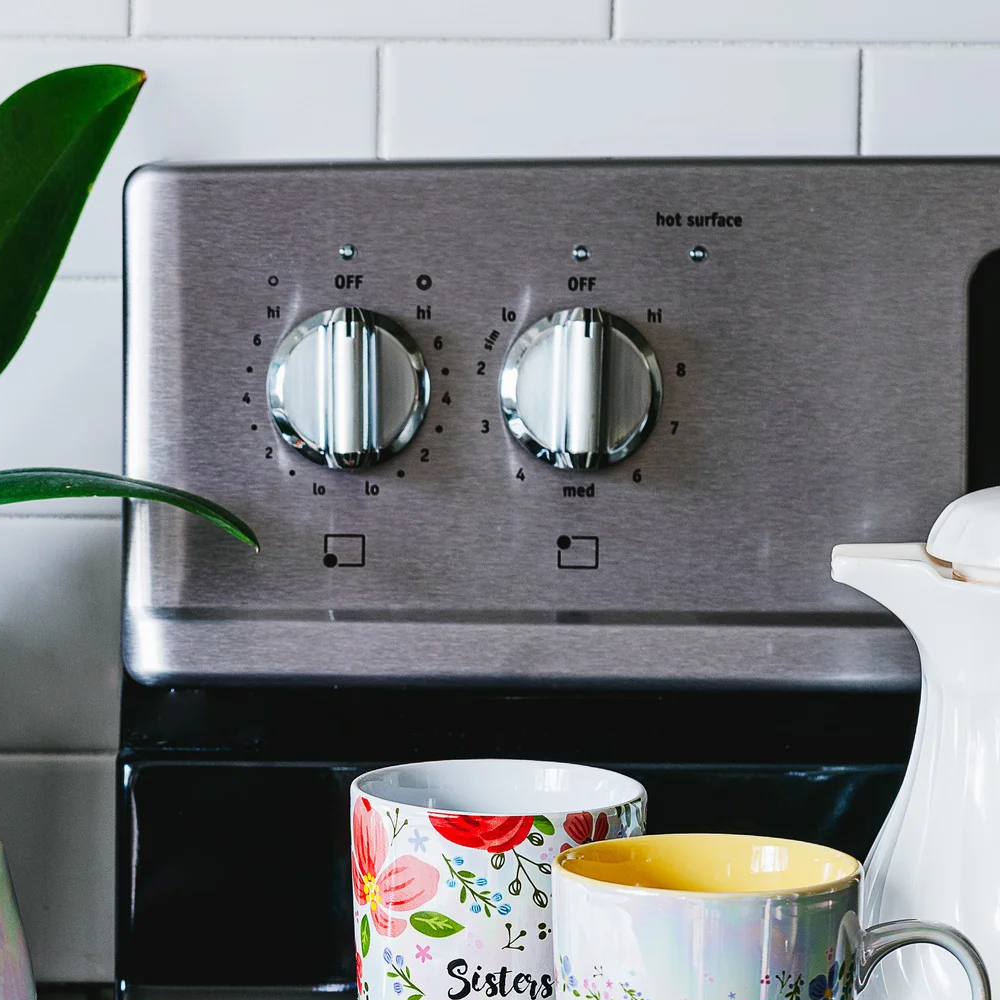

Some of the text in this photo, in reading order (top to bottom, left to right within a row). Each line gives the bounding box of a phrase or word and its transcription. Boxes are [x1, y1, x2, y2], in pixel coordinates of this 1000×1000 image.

[655, 211, 742, 227] hot surface
[334, 274, 364, 290] OFF
[567, 276, 597, 292] OFF
[266, 305, 281, 319] hi
[416, 304, 432, 321] hi
[501, 306, 517, 323] lo
[647, 308, 663, 324] hi
[252, 333, 262, 347] 6
[433, 335, 444, 351] 6
[484, 329, 500, 352] sim
[476, 360, 486, 376] 2
[675, 362, 687, 378] 8
[241, 392, 252, 404] 4
[441, 390, 452, 406] 4
[480, 419, 490, 434] 3
[670, 420, 680, 436] 7
[265, 446, 273, 460] 2
[420, 447, 430, 463] 2
[515, 467, 526, 482] 4
[632, 468, 642, 484] 6
[312, 482, 327, 496] lo
[364, 480, 380, 496] lo
[562, 482, 595, 498] med
[447, 959, 554, 1000] Sisters
